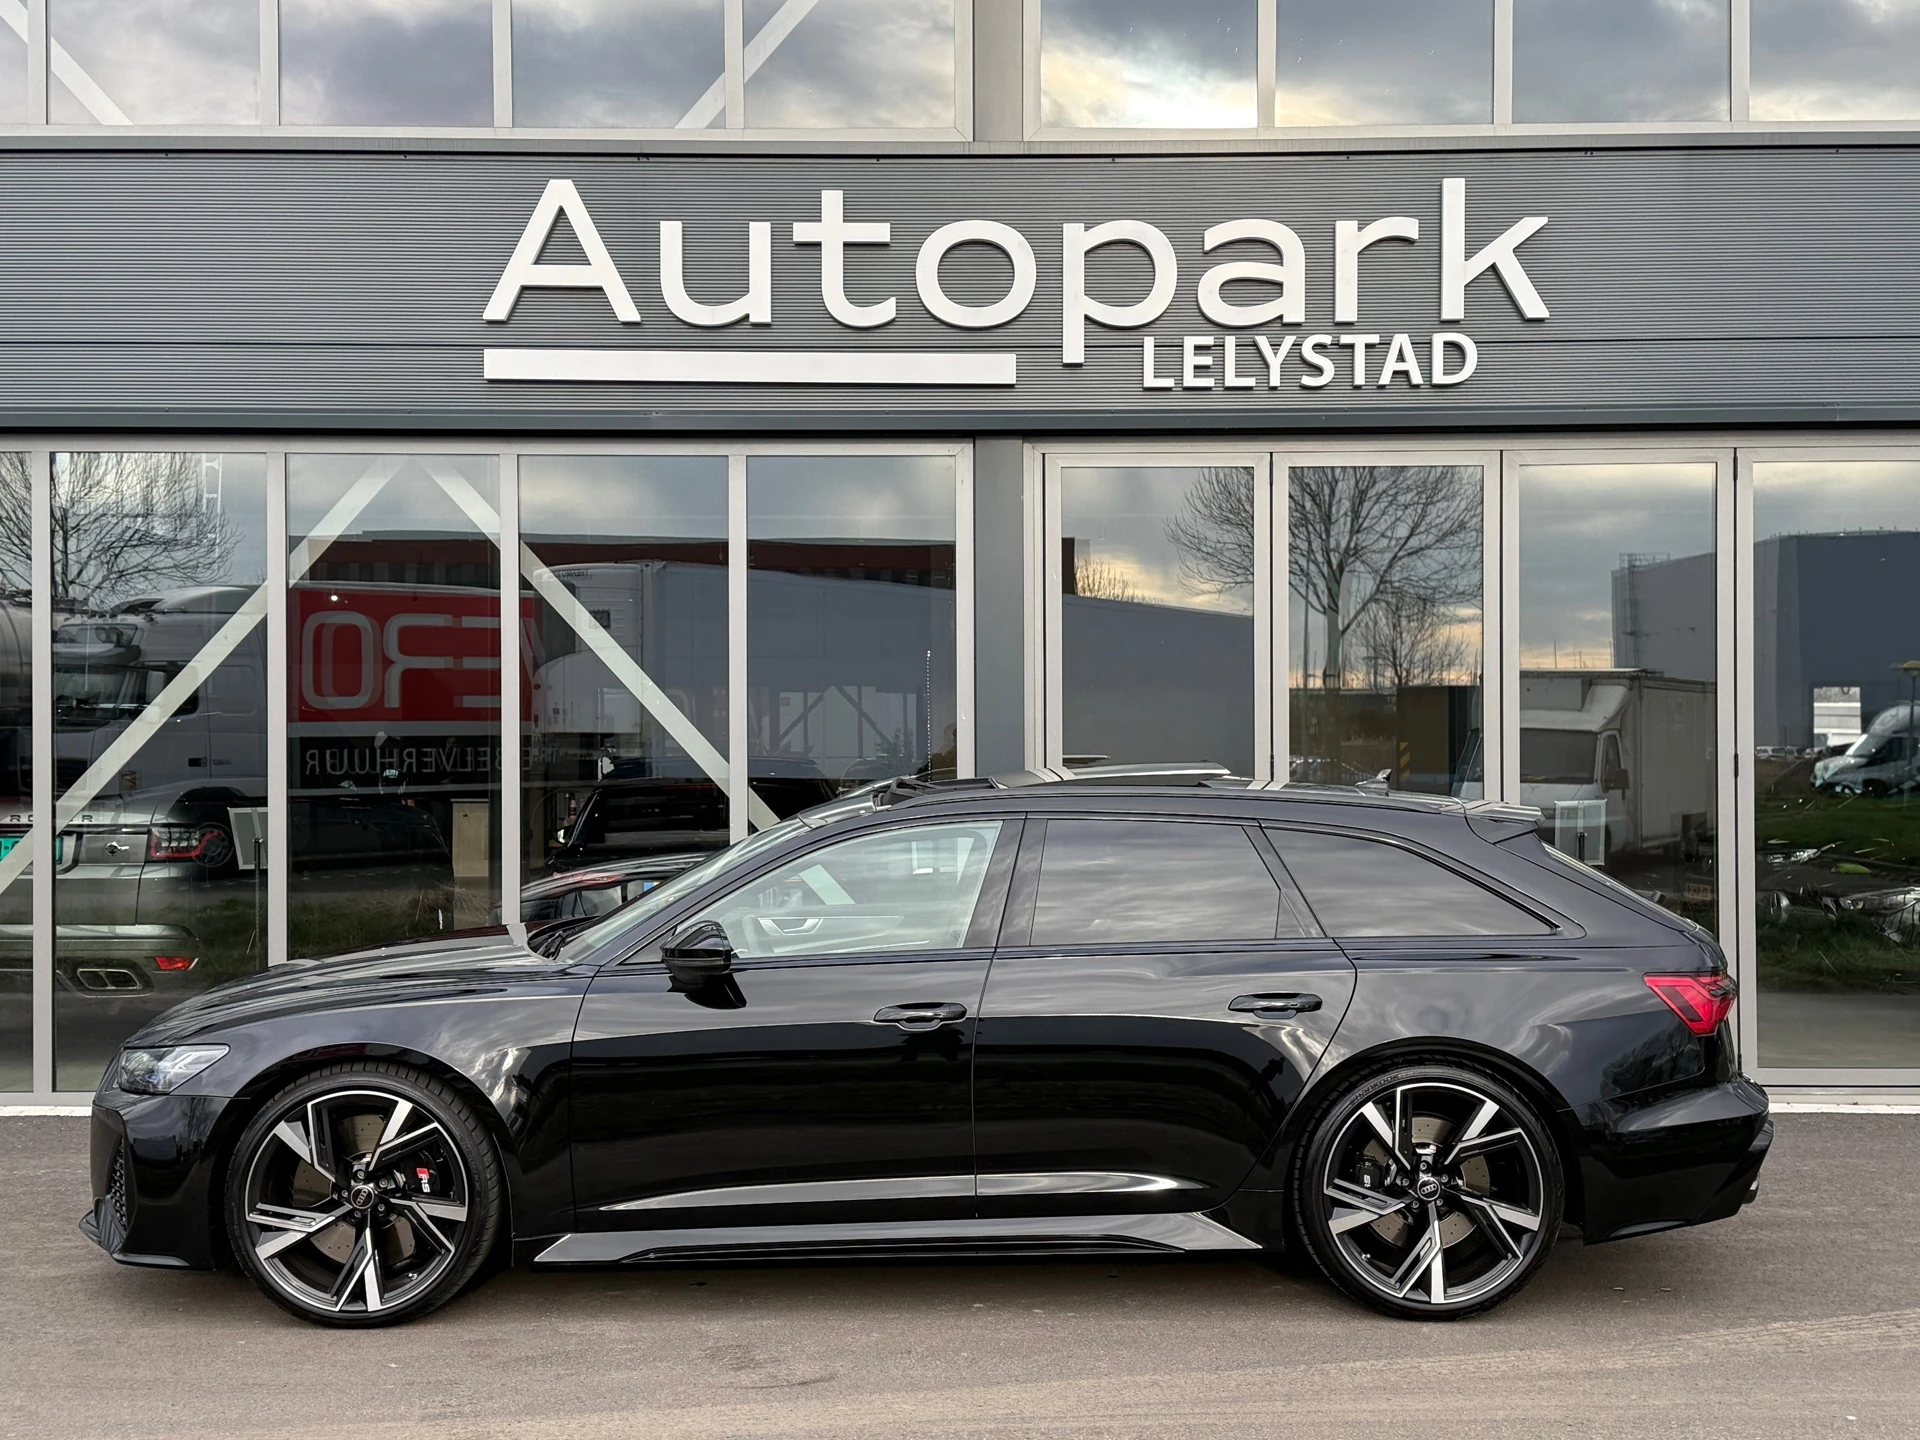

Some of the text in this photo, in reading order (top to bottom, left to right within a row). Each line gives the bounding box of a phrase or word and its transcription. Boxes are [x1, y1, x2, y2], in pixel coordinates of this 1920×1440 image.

[482, 177, 1550, 366] Autopark
[1142, 332, 1478, 389] LELYSTAD
[417, 1172, 430, 1192] RS
